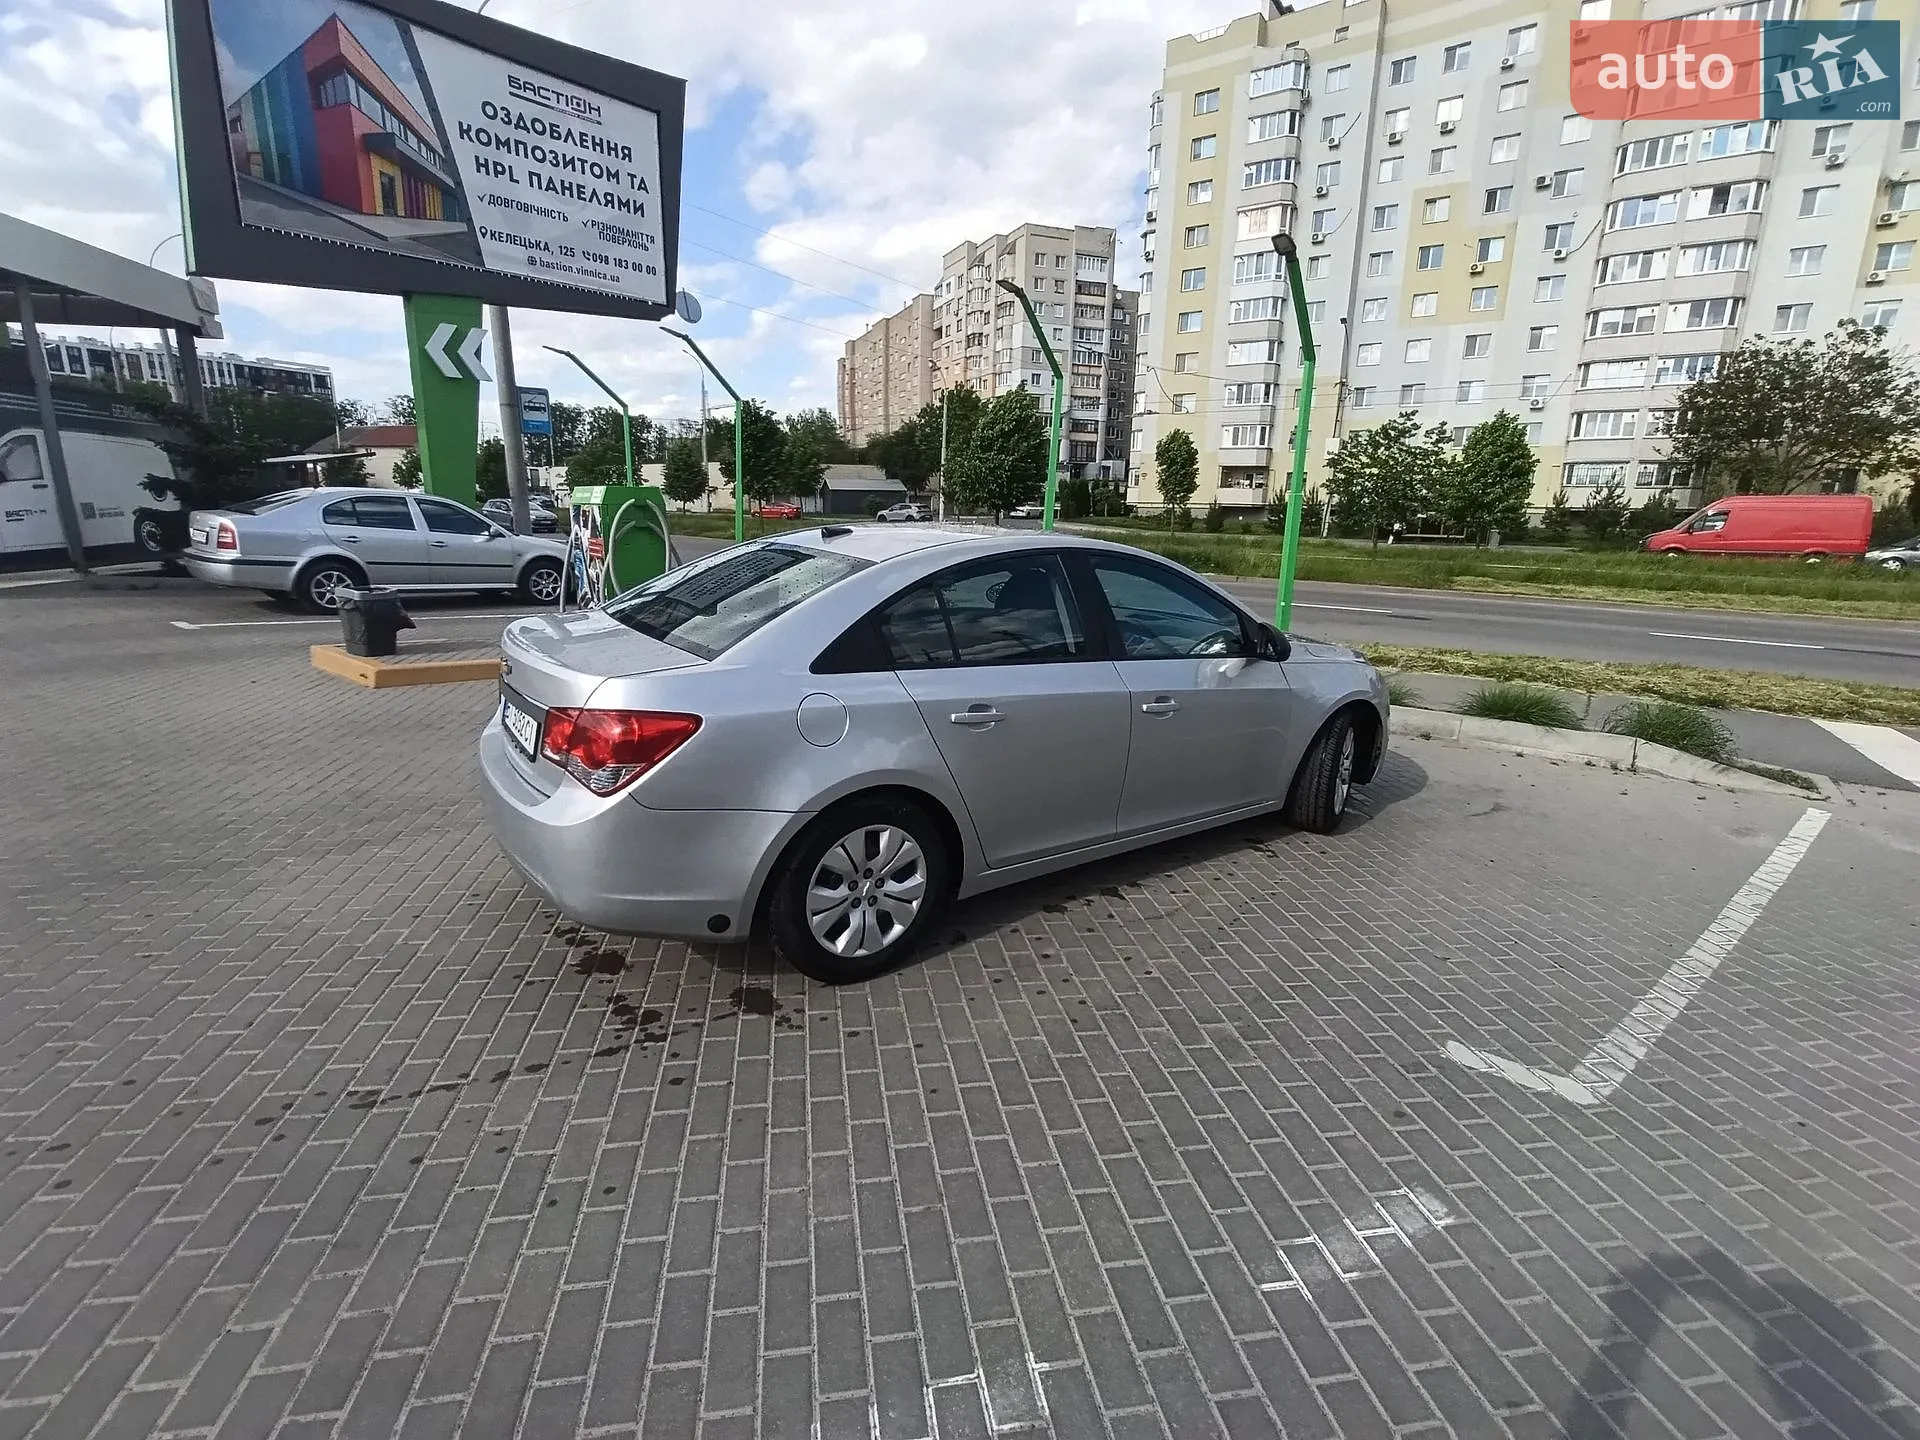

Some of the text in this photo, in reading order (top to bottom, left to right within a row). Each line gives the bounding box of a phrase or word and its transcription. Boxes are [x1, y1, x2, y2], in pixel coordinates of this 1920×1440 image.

[481, 100, 633, 163] ОЗДОБЛЕННЯ
[457, 120, 650, 194] КОМПОЗИТОМ ТА
[474, 155, 645, 218] HPL ПАНЕЛЯМИ
[487, 193, 569, 223] ДОВГОВІЧНІСТЬ
[489, 229, 576, 259] КЕЛЕЦЬКА, 125
[591, 219, 655, 245] РІЗНОМАНІТТЯ
[598, 231, 650, 252] ПОВЕРХОНЬ
[539, 256, 621, 283] bastion.vinnica.ua
[591, 252, 657, 277] 098 183 00 00
